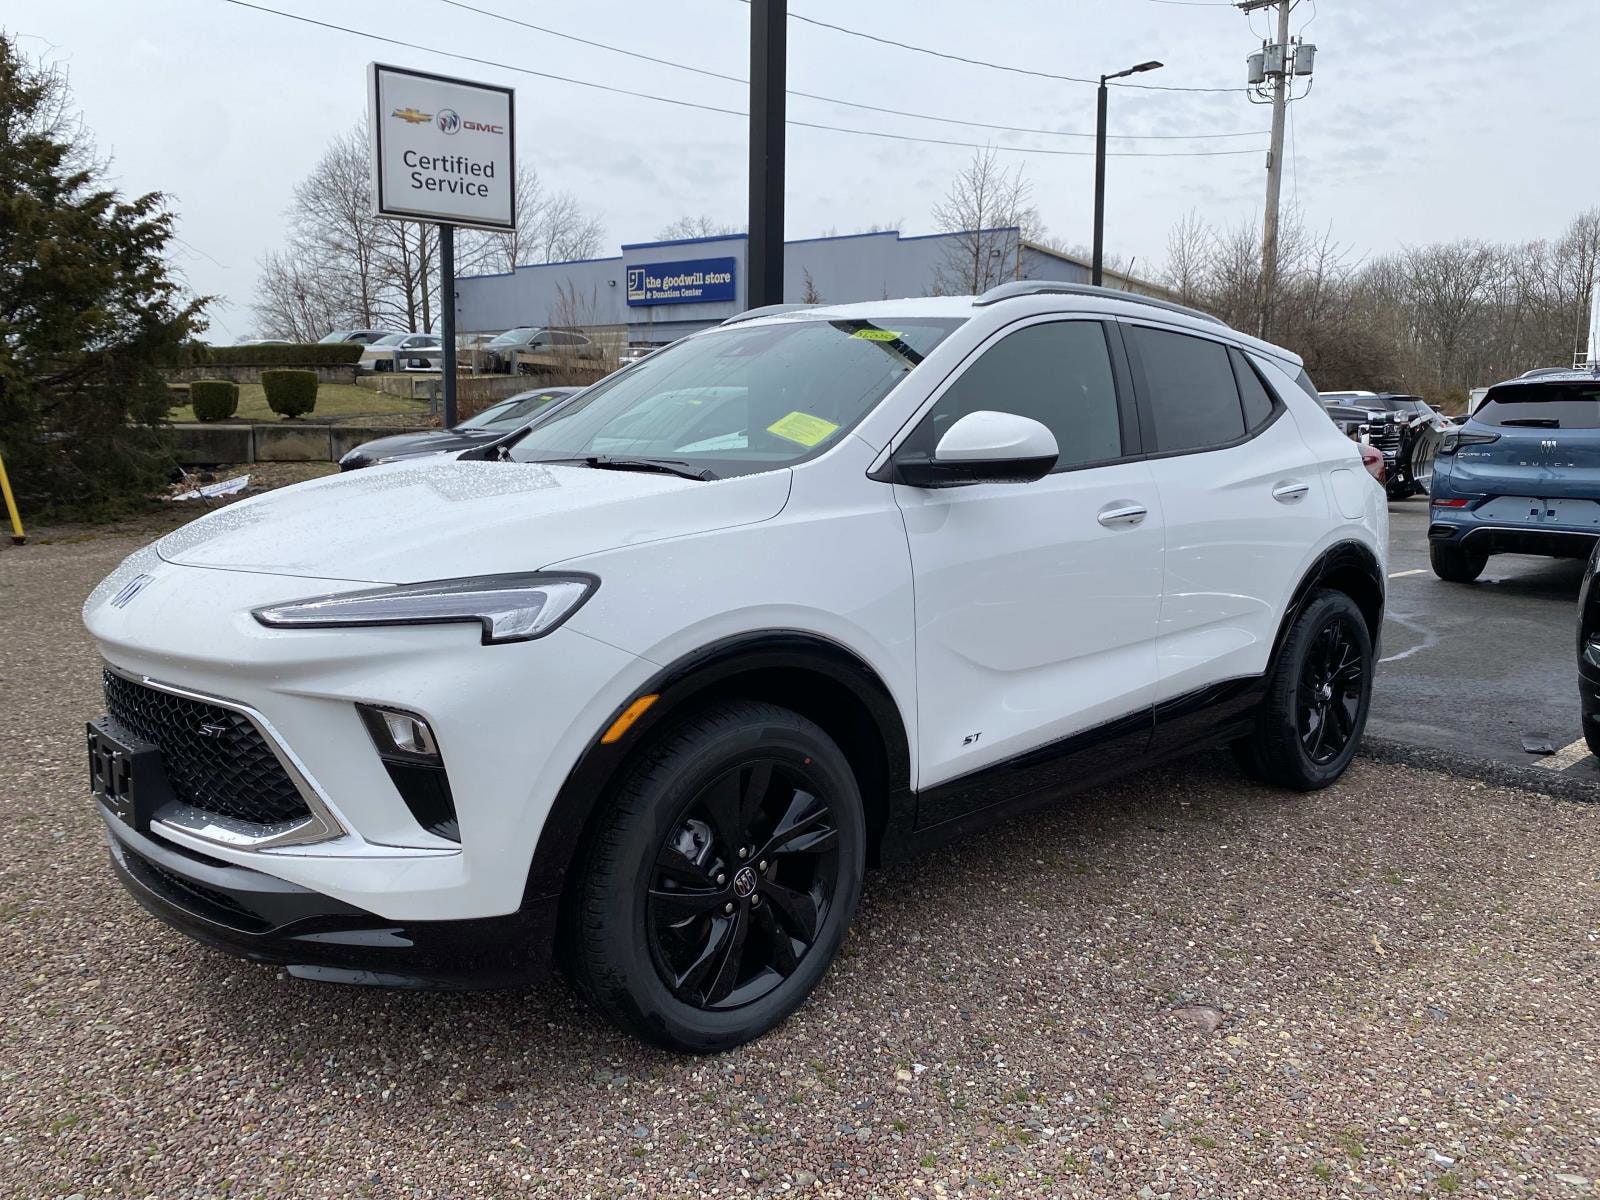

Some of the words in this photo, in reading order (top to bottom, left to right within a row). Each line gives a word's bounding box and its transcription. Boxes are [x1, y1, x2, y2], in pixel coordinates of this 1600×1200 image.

[463, 120, 503, 135] GMC
[403, 150, 495, 179] Certified
[411, 172, 488, 198] Service
[646, 276, 661, 288] the
[662, 272, 703, 290] goodwill
[705, 271, 731, 283] store
[653, 289, 680, 299] Donation
[681, 288, 702, 297] Center
[962, 732, 982, 746] ST
